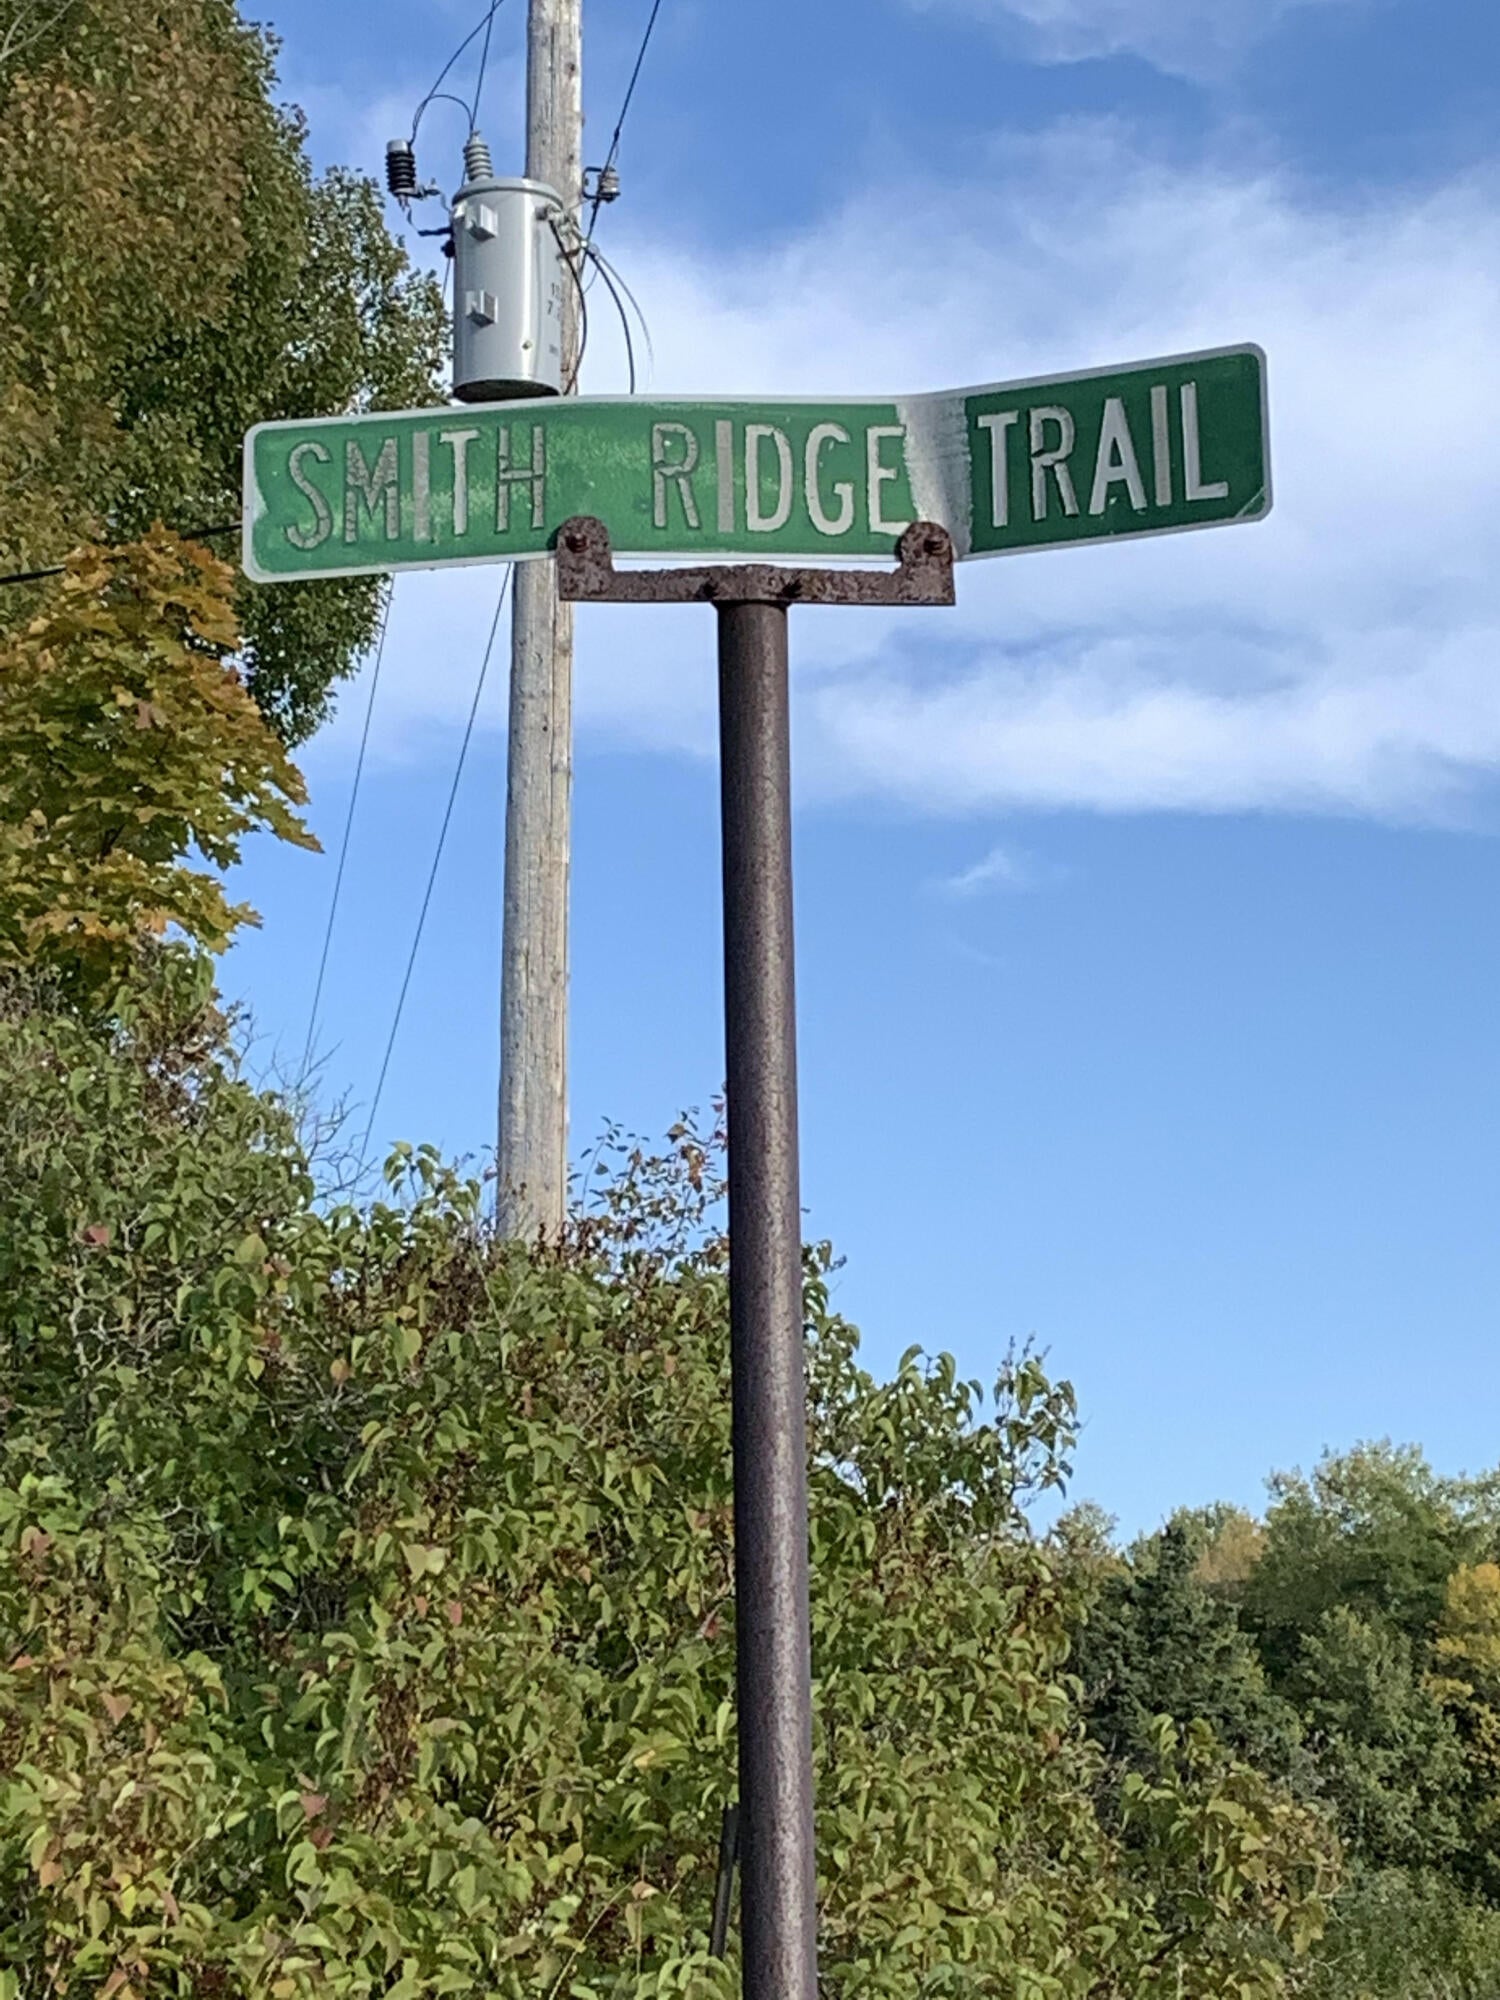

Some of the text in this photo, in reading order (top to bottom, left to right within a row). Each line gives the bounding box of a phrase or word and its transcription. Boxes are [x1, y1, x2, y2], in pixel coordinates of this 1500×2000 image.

[286, 382, 1228, 549] SMITH RIDGE TRAIL
